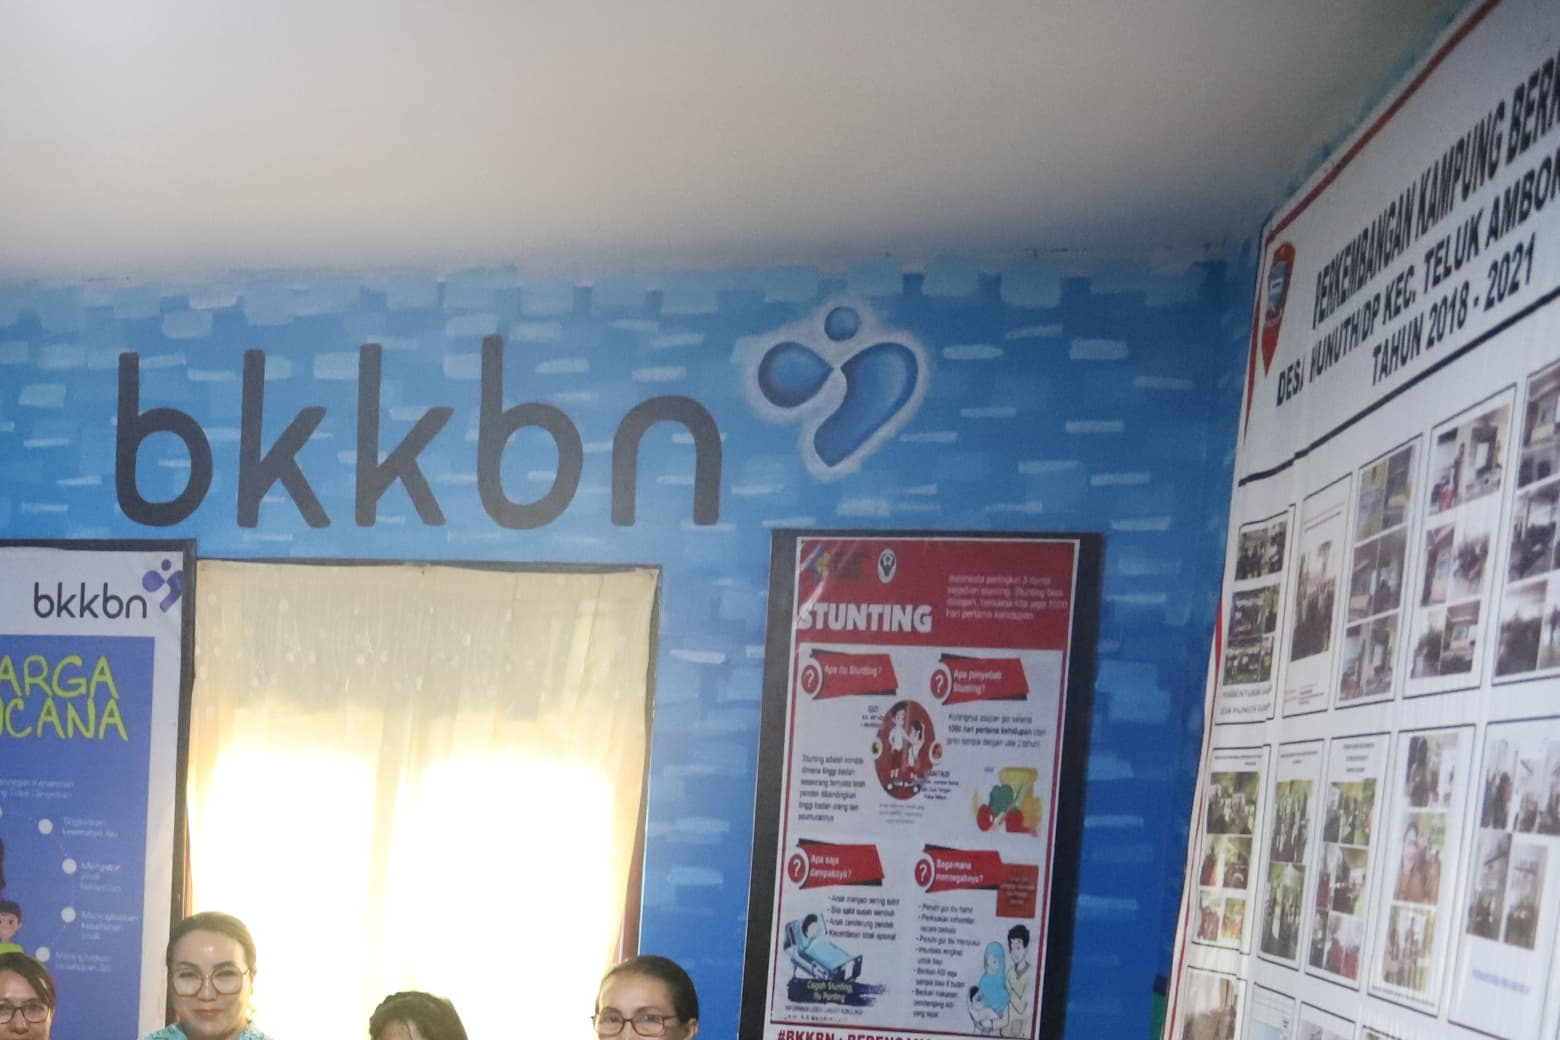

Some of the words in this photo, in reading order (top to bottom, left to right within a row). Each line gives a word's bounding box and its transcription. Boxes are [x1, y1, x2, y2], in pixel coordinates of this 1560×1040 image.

[1416, 99, 1506, 241] KAMPUNG
[1372, 312, 1424, 386] TAHUN
[1426, 281, 1470, 350] 2018
[1484, 231, 1536, 312] 2021
[1382, 264, 1417, 326] KEC.
[1424, 205, 1484, 294] TELUK
[115, 334, 723, 529] bkkbn
[33, 582, 147, 619] bkkbn
[796, 601, 933, 634] STUNTING
